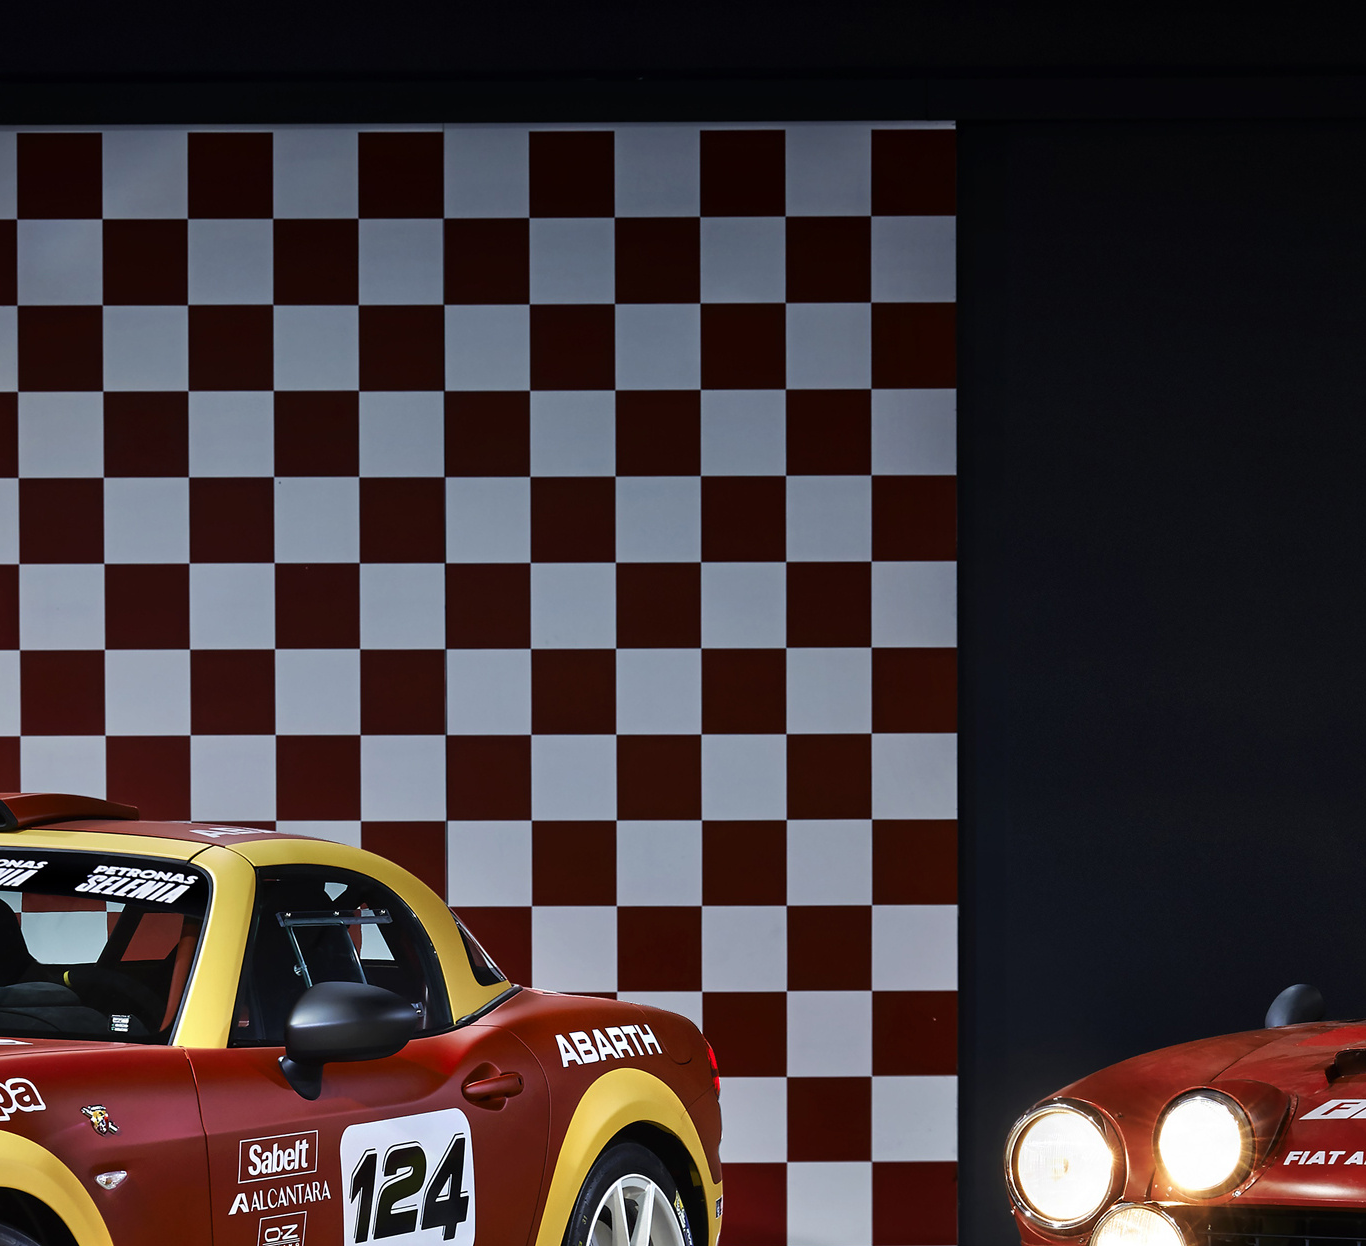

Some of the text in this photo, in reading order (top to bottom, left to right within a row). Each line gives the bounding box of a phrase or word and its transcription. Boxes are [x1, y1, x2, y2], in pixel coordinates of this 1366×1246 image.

[75, 874, 190, 904] SELENIA
[92, 865, 198, 885] PETRONAS
[555, 1023, 663, 1068] ABARTH
[247, 1138, 309, 1176] Sabelt
[1283, 1150, 1346, 1166] FIAT
[250, 1180, 332, 1212] ALCANTARA
[348, 1131, 470, 1245] 124
